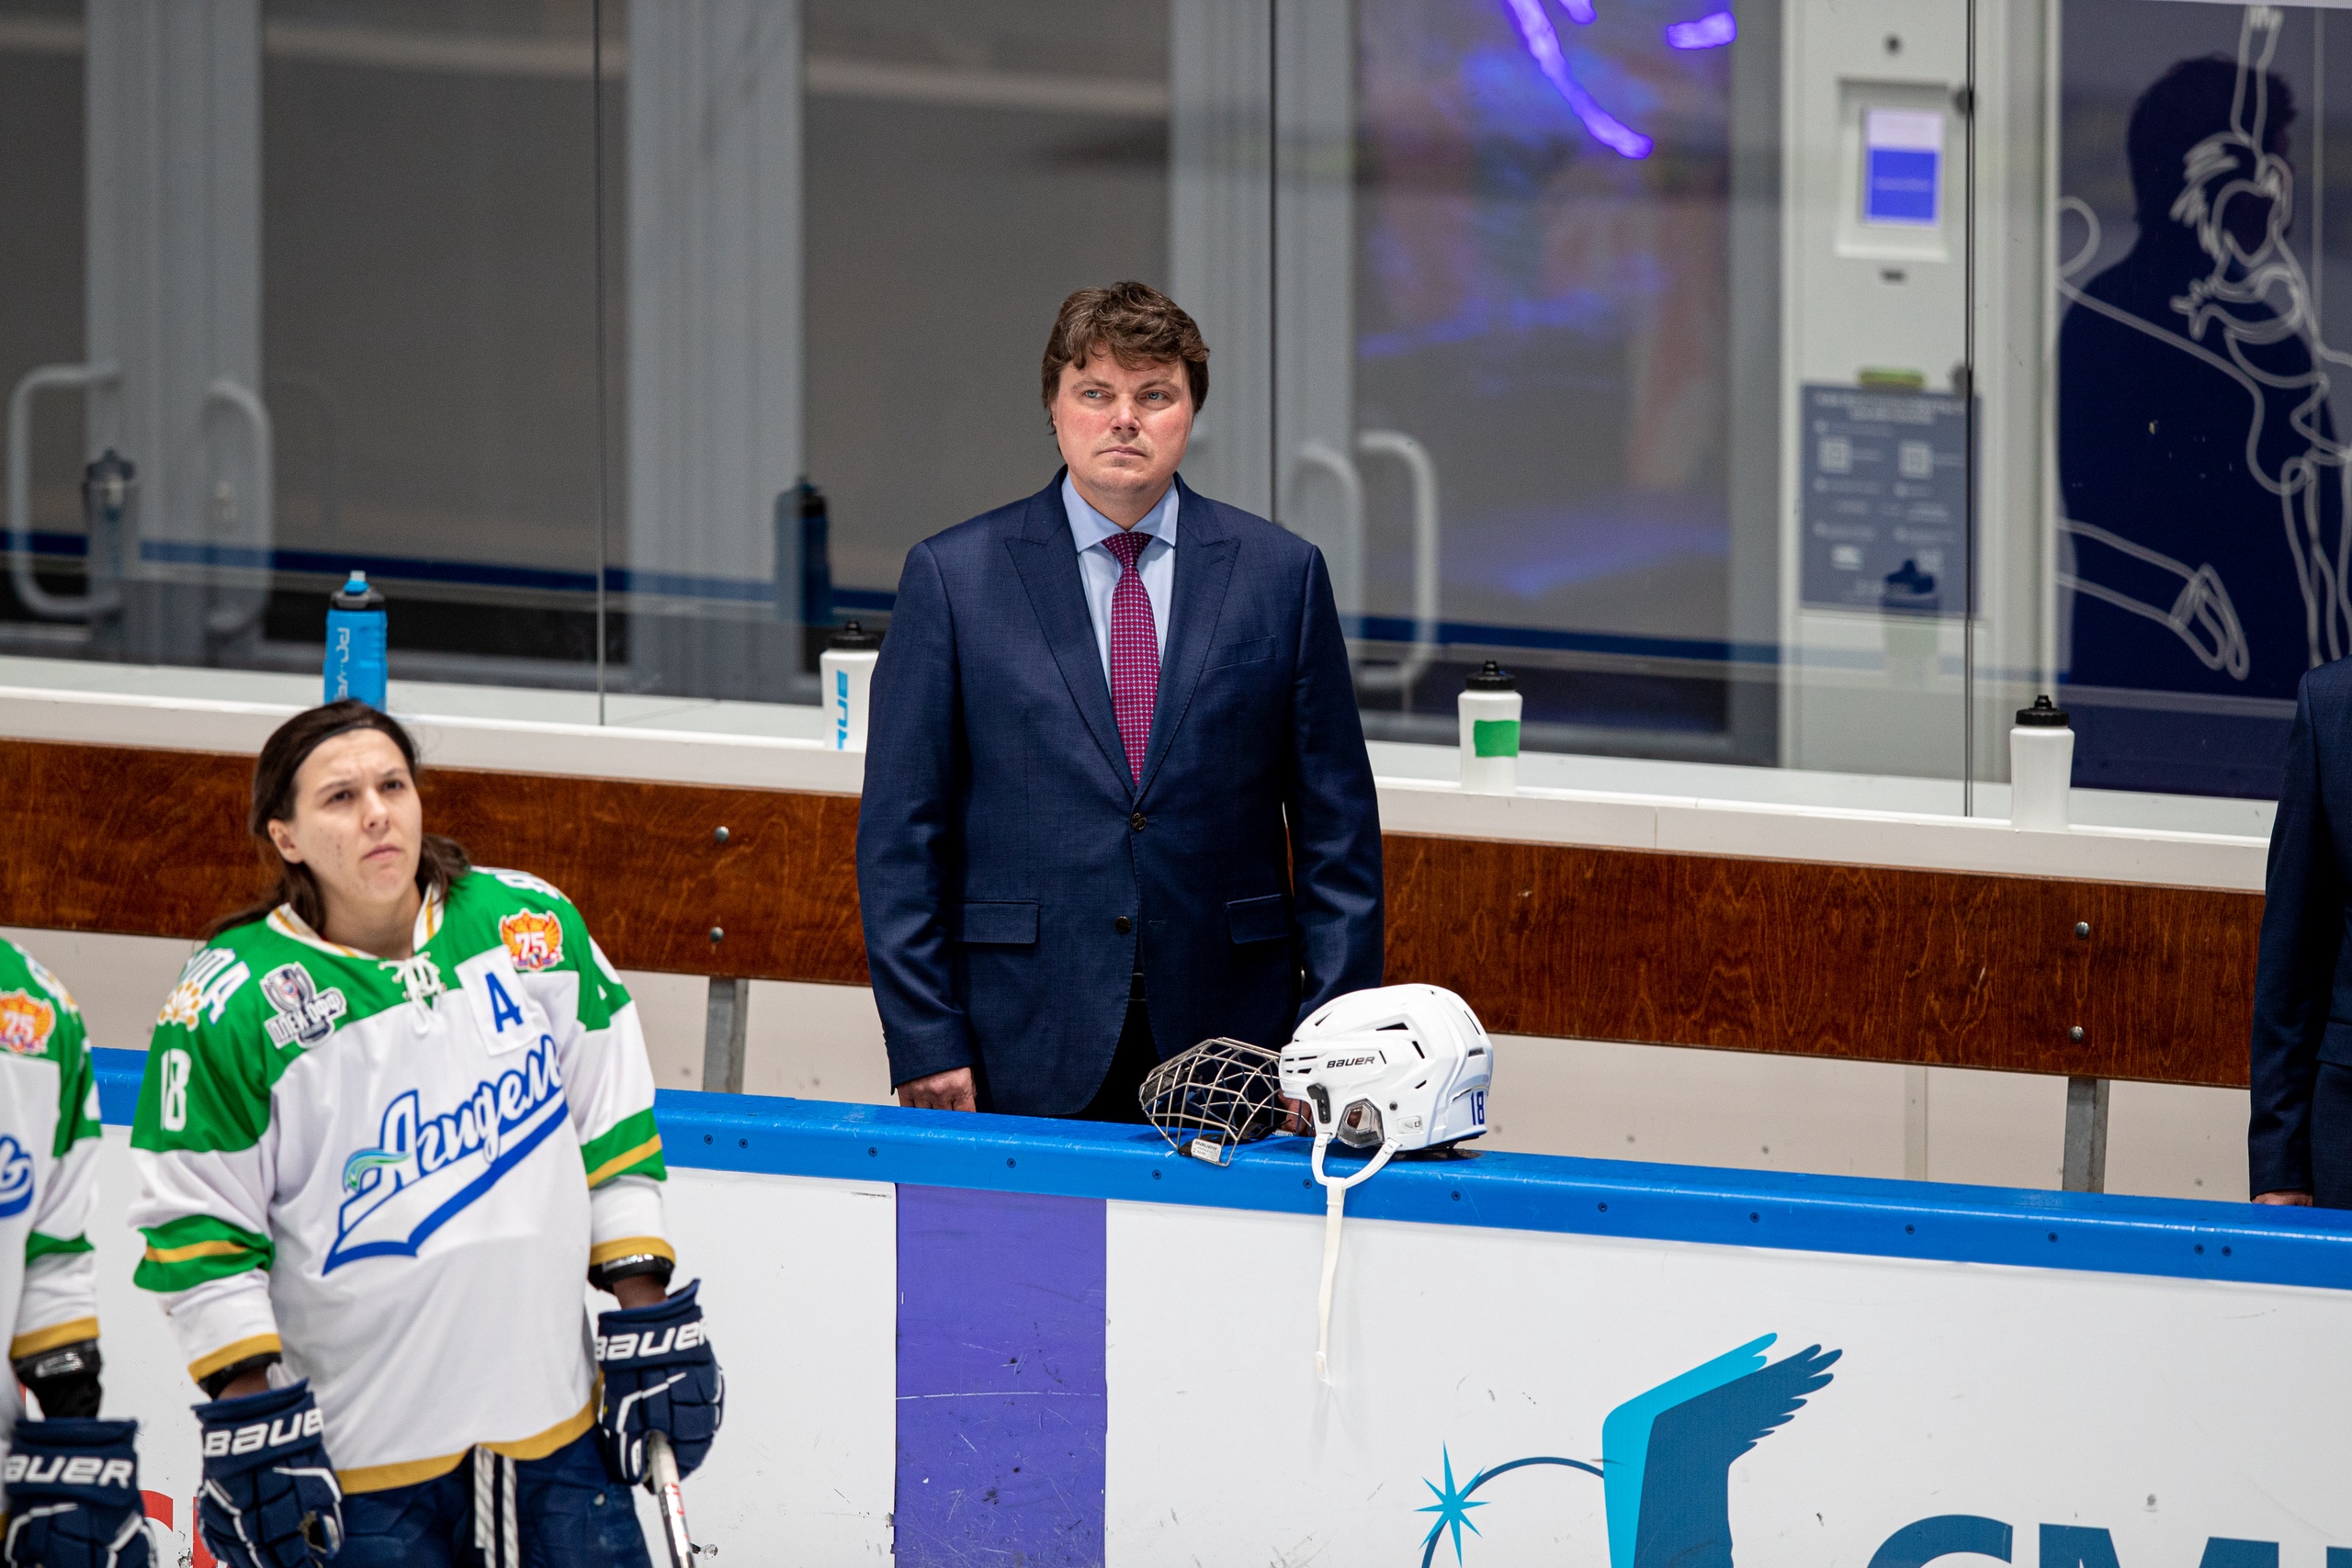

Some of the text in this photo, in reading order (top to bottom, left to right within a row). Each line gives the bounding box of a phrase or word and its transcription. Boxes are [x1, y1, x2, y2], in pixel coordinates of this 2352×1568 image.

[514, 931, 549, 959] 75
[485, 971, 524, 1033] A
[5, 1011, 35, 1043] 75
[1327, 1056, 1375, 1068] BAUER
[161, 1049, 191, 1132] 18
[1471, 1090, 1485, 1125] 18
[204, 1407, 323, 1457] BAUE
[5, 1454, 133, 1488] AUER
